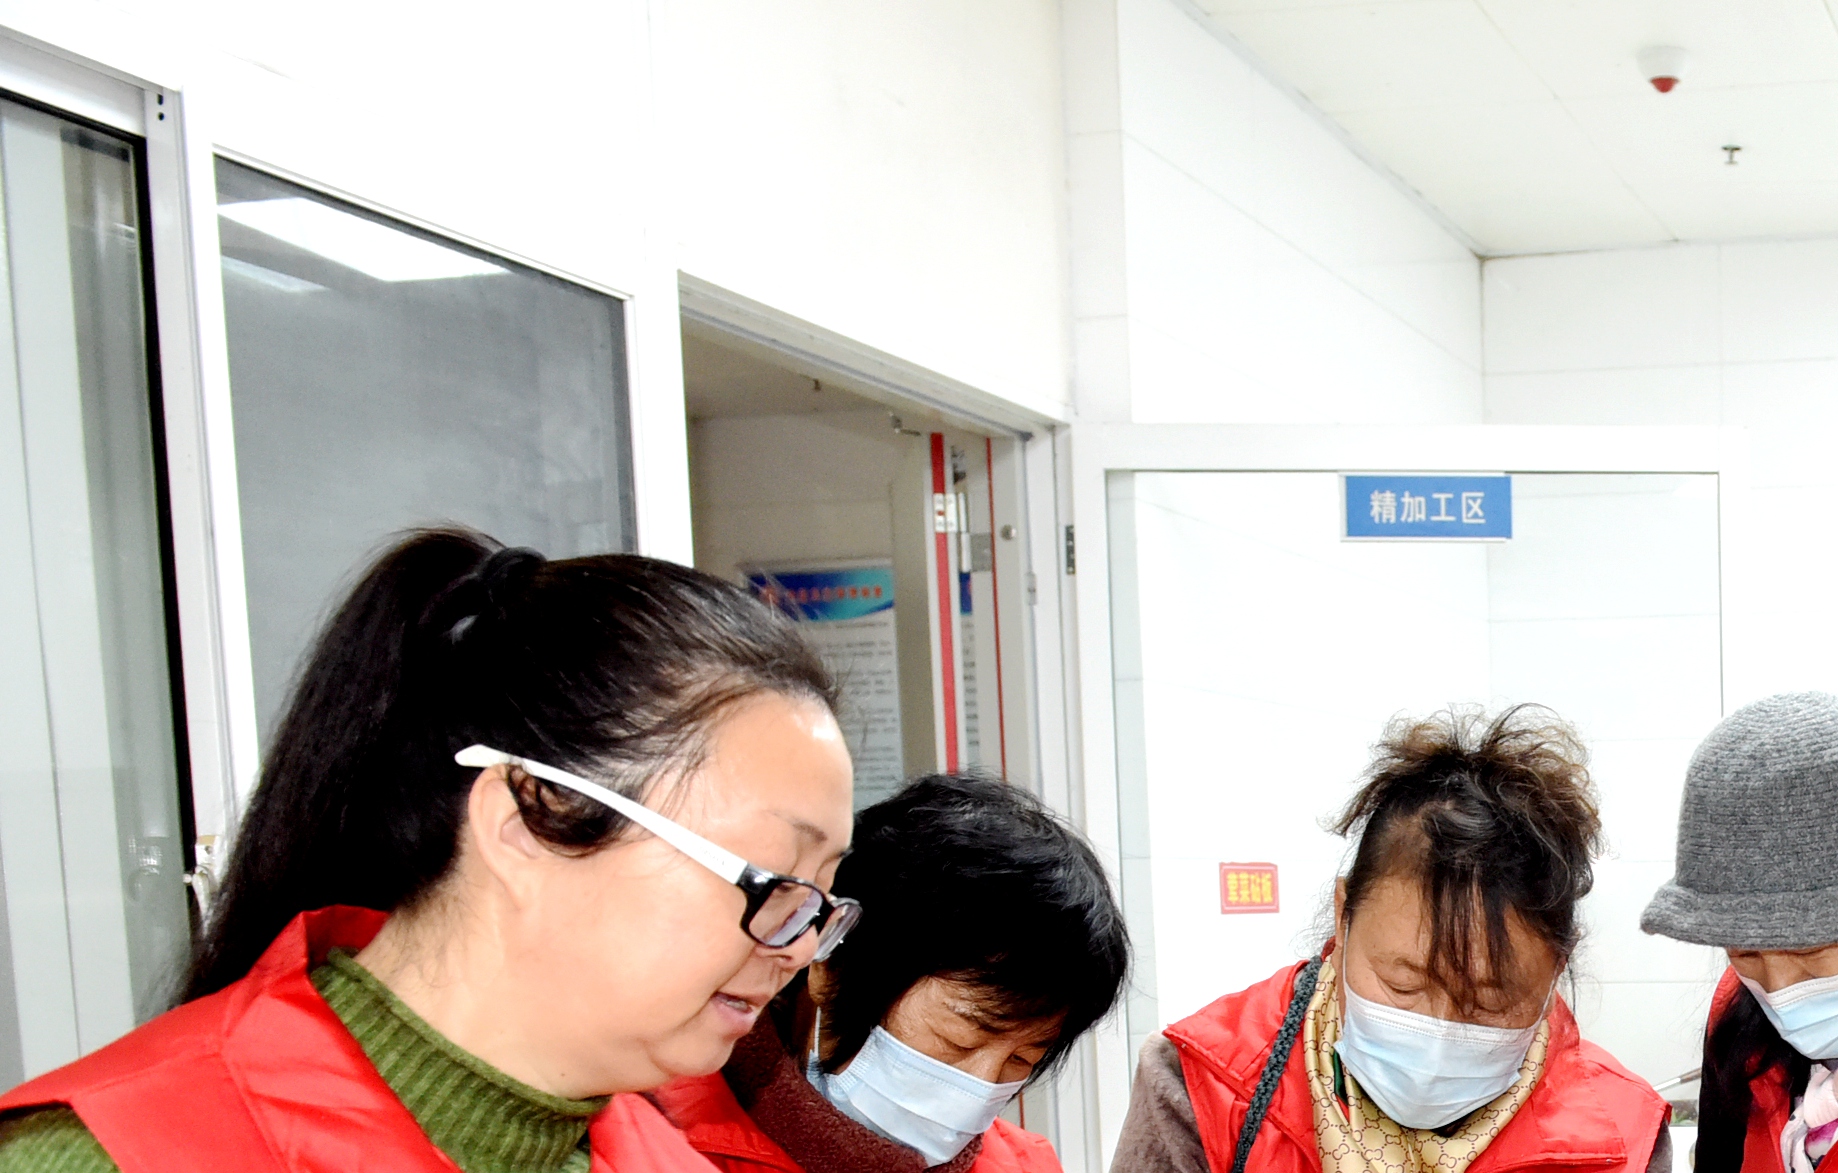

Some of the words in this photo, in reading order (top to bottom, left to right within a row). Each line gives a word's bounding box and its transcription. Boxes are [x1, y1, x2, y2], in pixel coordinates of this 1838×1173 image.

[1370, 490, 1486, 524] 精加工区
[1227, 871, 1273, 904] 荤菜砧板
